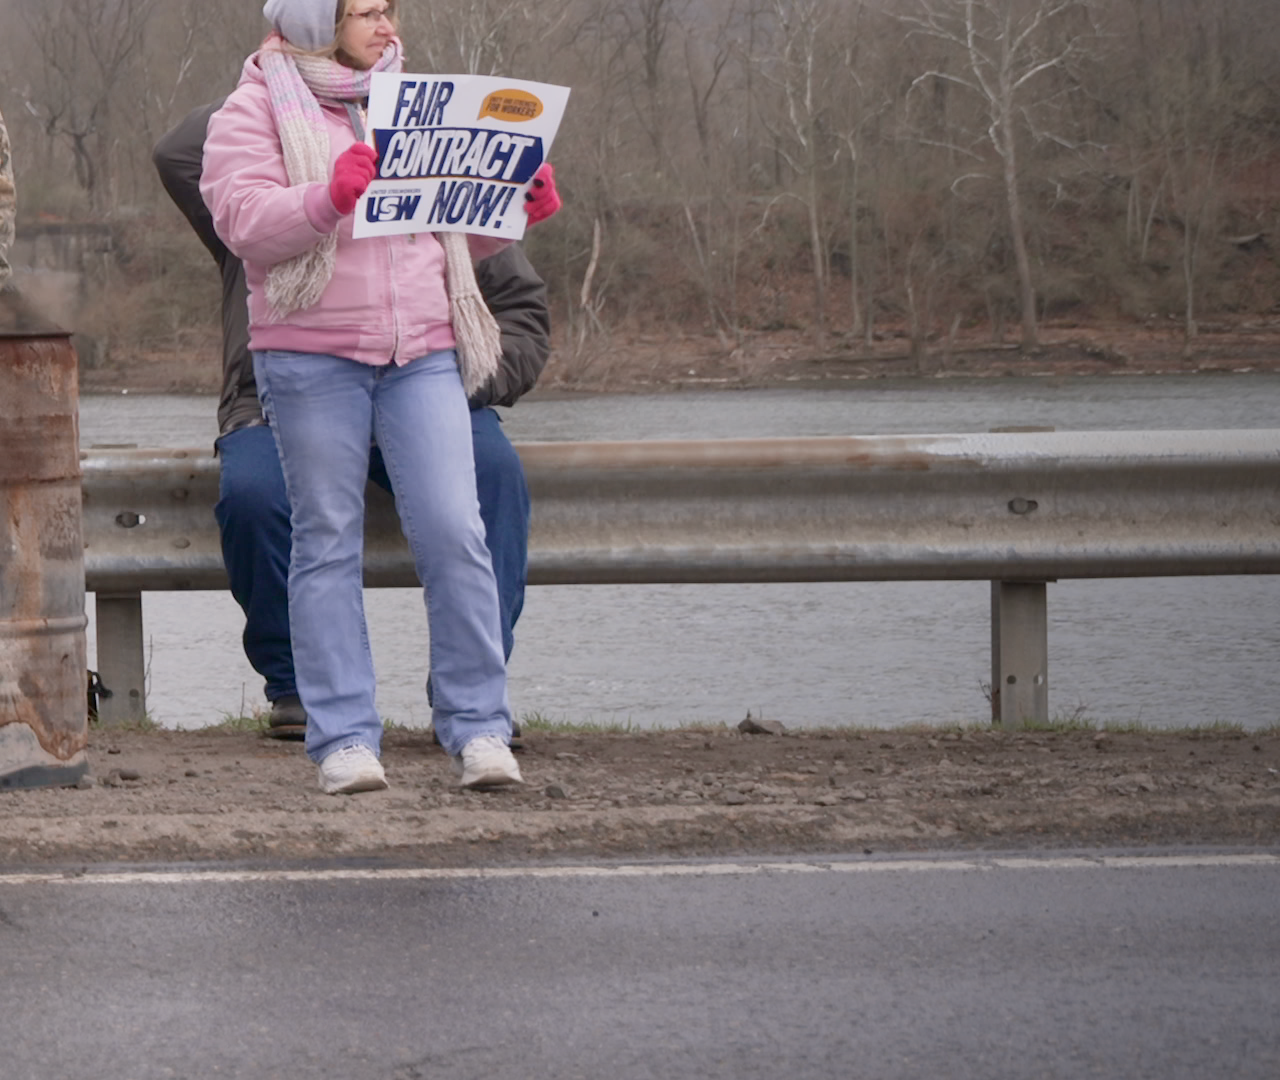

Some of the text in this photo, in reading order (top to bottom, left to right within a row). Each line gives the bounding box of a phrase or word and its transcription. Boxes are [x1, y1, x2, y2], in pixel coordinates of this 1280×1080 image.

[391, 80, 455, 127] FAIR
[379, 128, 536, 181] CONTRACT
[366, 194, 423, 223] USW
[427, 180, 518, 230] NOW!
